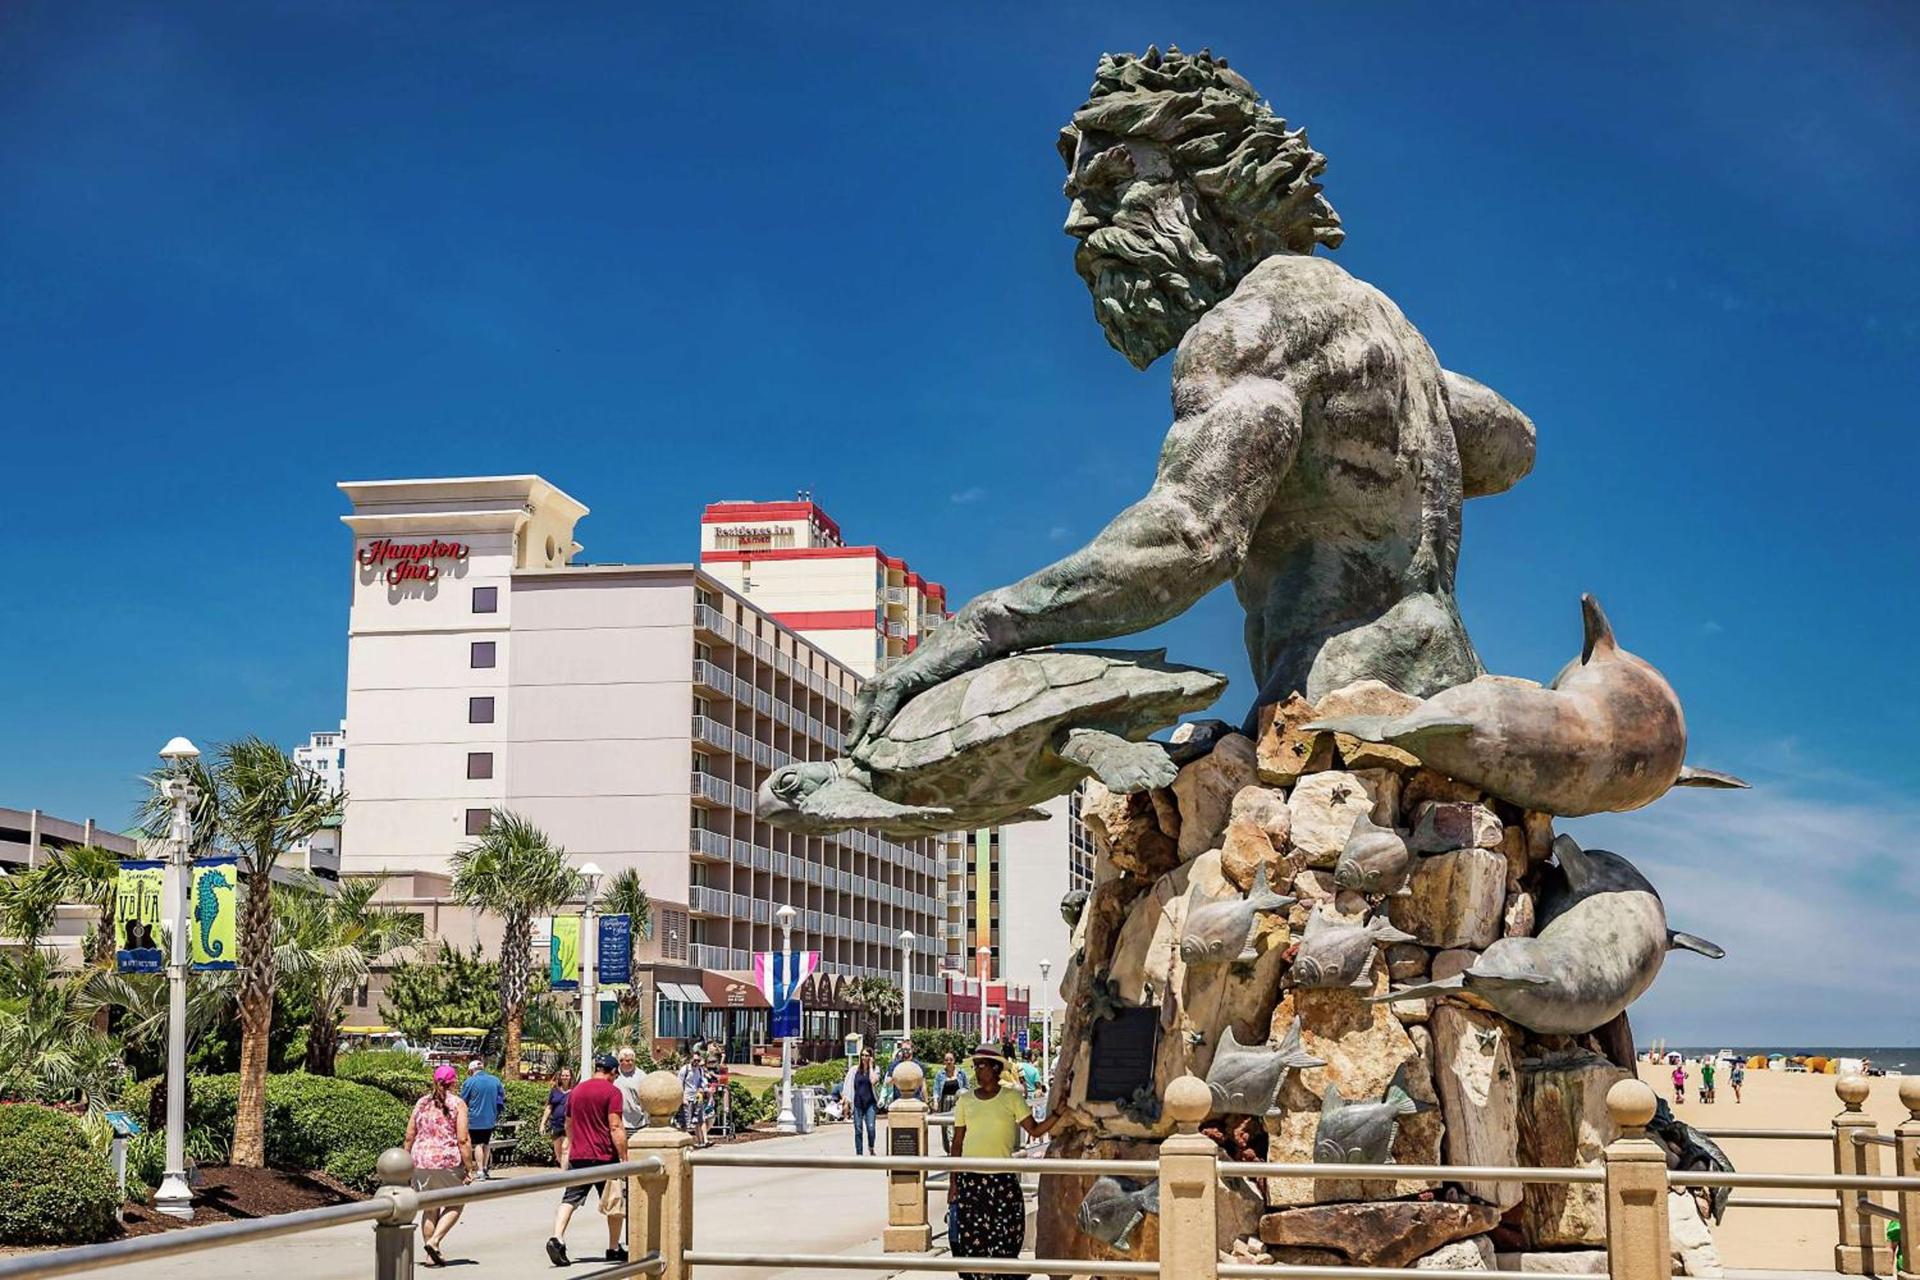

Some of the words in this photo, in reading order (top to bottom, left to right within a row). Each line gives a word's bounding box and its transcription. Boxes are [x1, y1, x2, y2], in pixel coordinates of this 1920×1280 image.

[714, 525, 771, 537] Residence
[358, 538, 469, 566] Hampton
[386, 560, 439, 586] Inn
